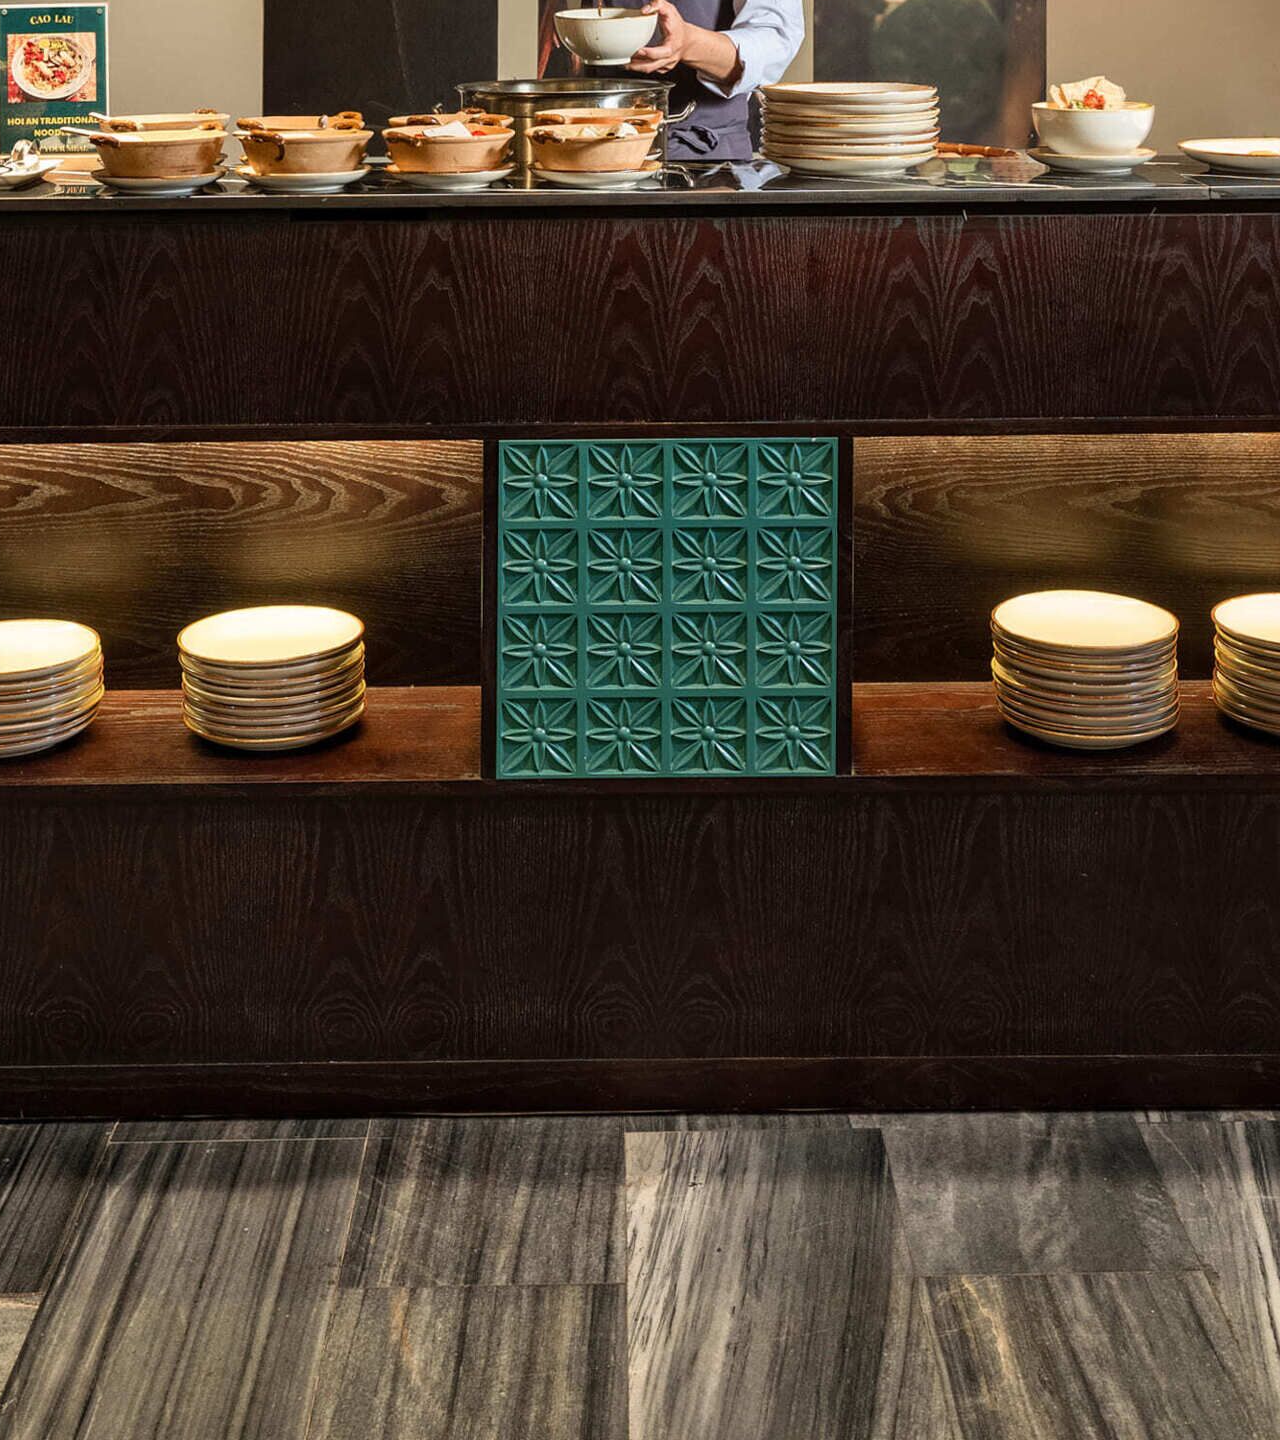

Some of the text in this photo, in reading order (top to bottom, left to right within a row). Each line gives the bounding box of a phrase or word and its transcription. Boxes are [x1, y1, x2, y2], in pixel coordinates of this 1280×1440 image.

[30, 14, 74, 25] CAO LAU
[7, 117, 24, 126] HOI
[25, 117, 39, 125] AN
